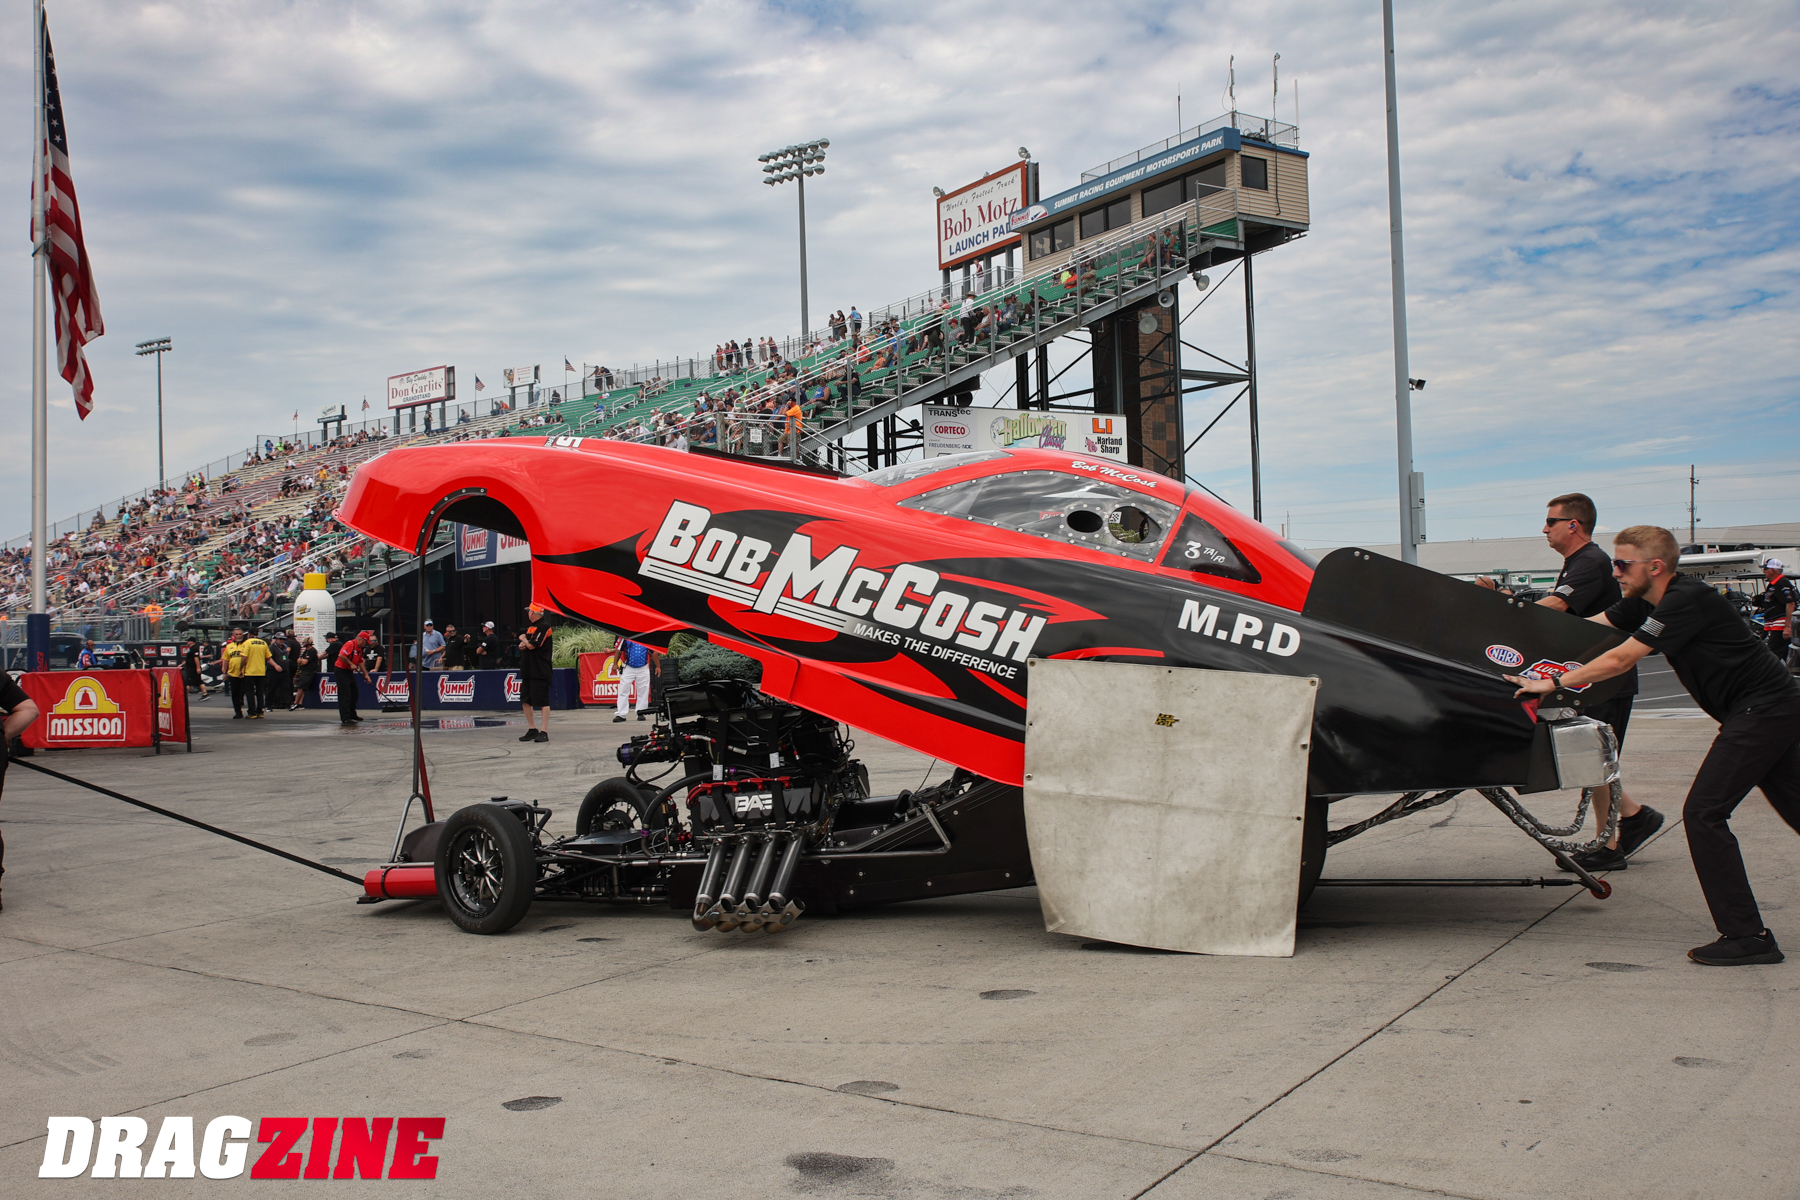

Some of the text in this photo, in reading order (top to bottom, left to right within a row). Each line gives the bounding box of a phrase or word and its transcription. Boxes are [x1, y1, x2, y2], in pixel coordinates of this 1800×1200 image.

[1054, 136, 1223, 209] SUMMIT RACING EQUIPMENT MOTORSPORTS PARK
[971, 187, 994, 202] Fastest
[943, 197, 1018, 241] Bob Motz
[949, 230, 990, 256] LAUNCH
[391, 387, 409, 399] Don
[403, 393, 431, 402] GRANDSTAND
[934, 425, 966, 435] CORTECO
[1000, 413, 1067, 446] Halloween
[1097, 436, 1122, 445] Harland
[1101, 445, 1120, 454] Sharp
[1071, 460, 1157, 488] Bob McCosh
[647, 499, 772, 585] BOB
[1184, 540, 1202, 559] 3
[1177, 599, 1301, 657] M.P.D
[853, 623, 1018, 680] MAKES THE DIFFERENCE
[1491, 648, 1520, 664] NHRA
[440, 677, 473, 698] SUMMIT
[51, 717, 122, 736] MISSION
[735, 793, 772, 812] BAE
